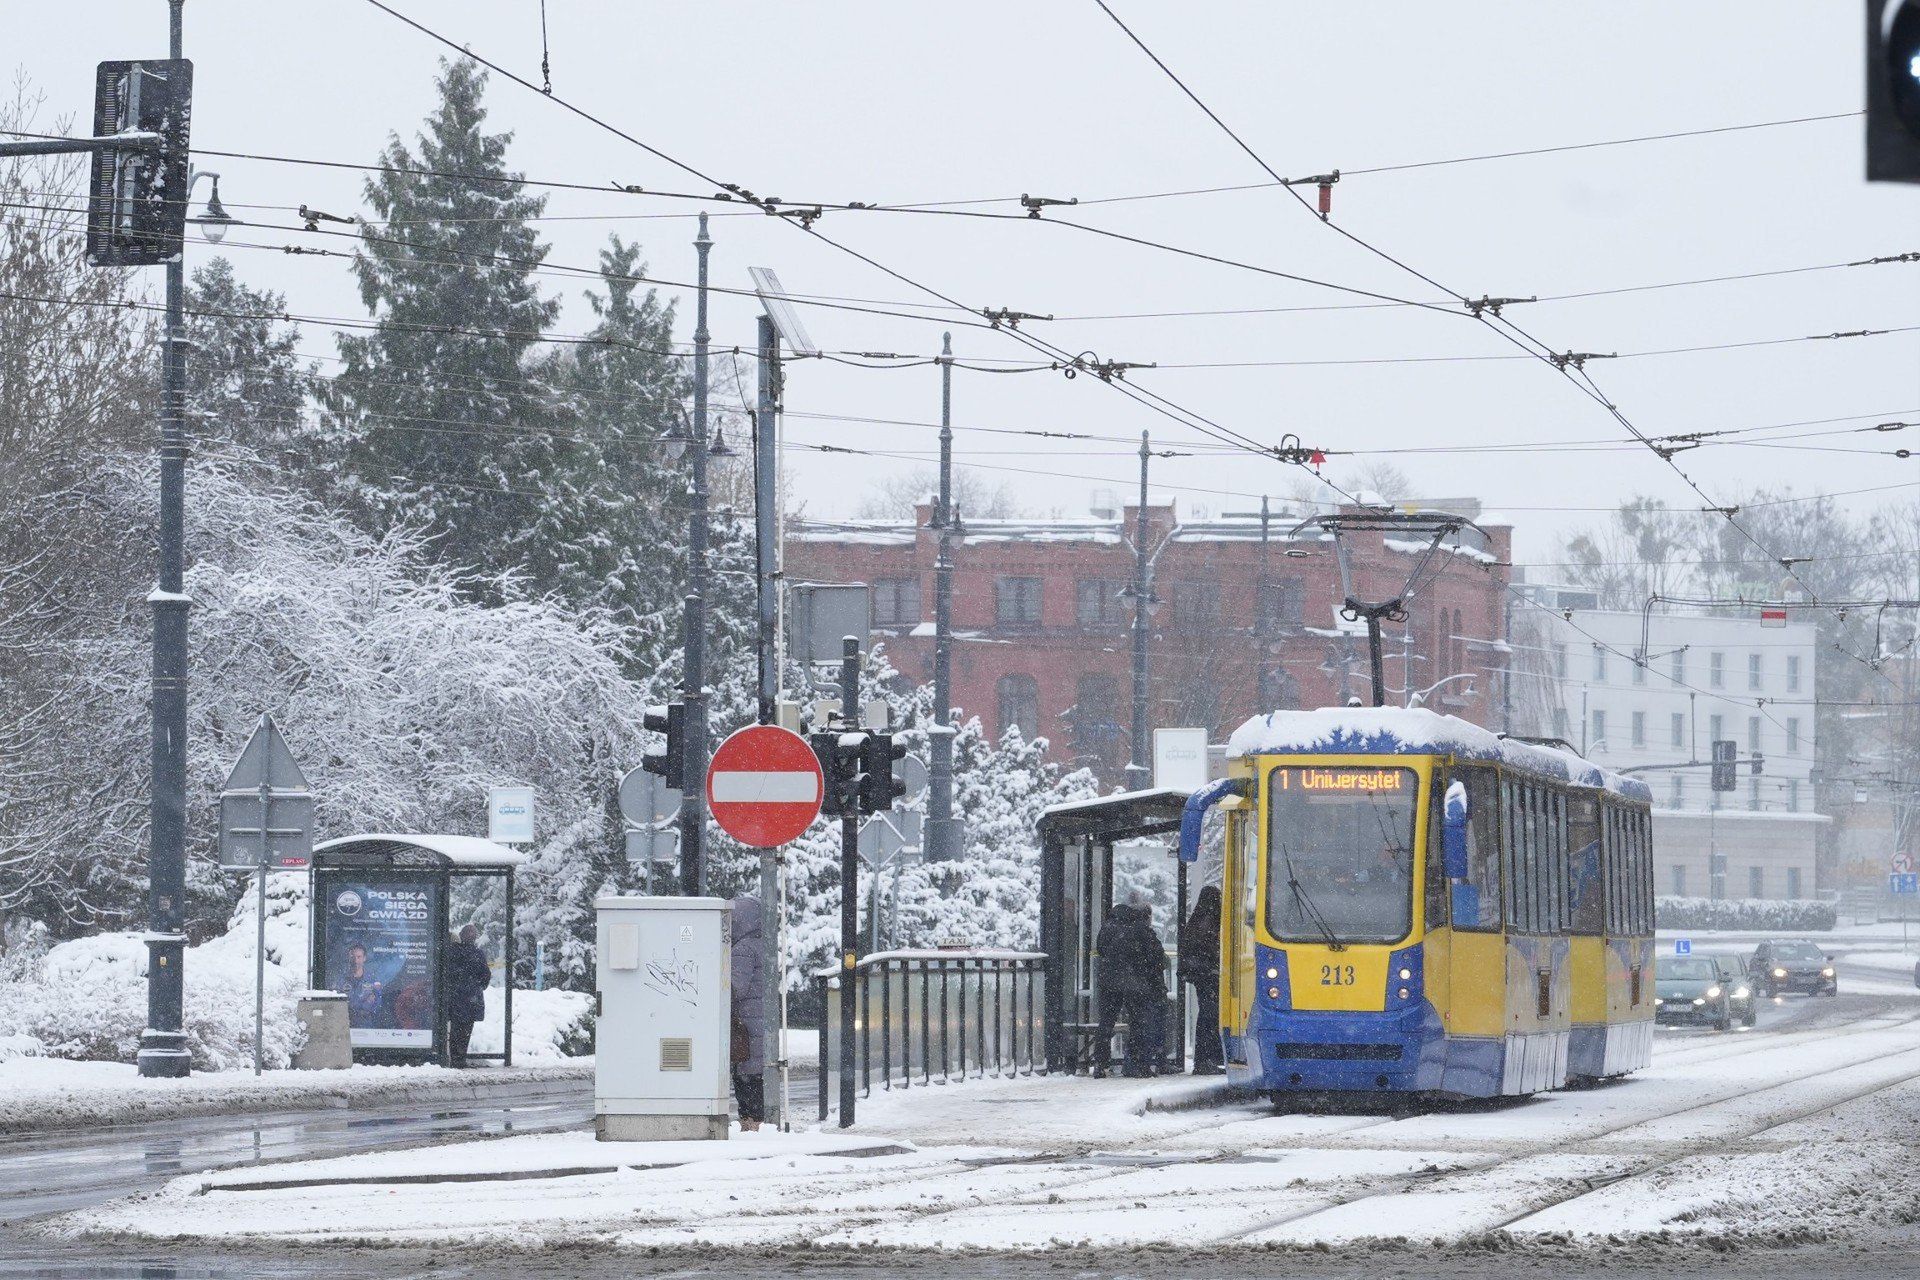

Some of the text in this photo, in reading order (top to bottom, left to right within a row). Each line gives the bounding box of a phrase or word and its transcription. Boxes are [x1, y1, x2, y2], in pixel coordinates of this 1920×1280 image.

[1279, 769, 1401, 790] 1 Uniwersytet
[367, 891, 428, 901] POLSKA
[384, 901, 428, 911] SIĘGA
[368, 911, 428, 919] GWIAZD
[1680, 942, 1688, 952] L
[1321, 964, 1355, 986] 213
